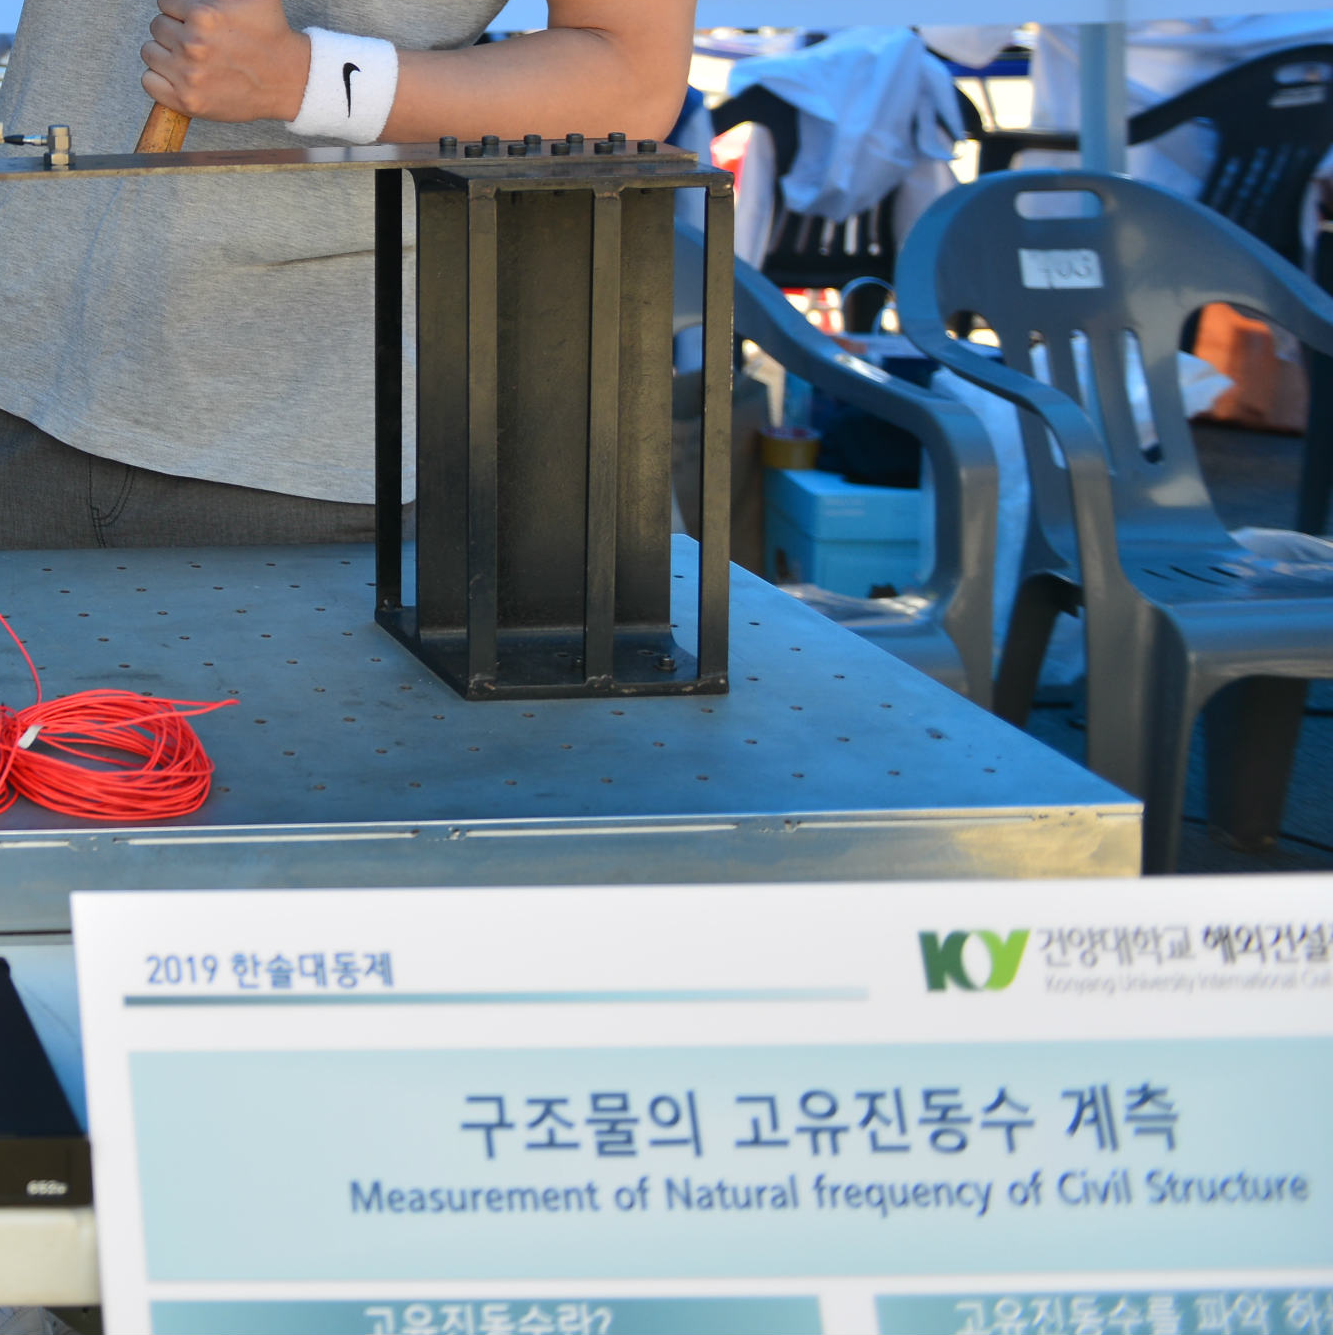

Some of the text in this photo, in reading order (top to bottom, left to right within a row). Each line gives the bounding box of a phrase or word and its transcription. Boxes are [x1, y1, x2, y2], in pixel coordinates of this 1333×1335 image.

[1037, 922, 1333, 968] 건양대학교 해외건설
[145, 952, 395, 989] 2019 한솔대동제
[460, 1082, 1181, 1161] 구조물의 고유진동수 계측
[349, 1168, 1310, 1218] Measurement of Natural frequency of Civil Structure
